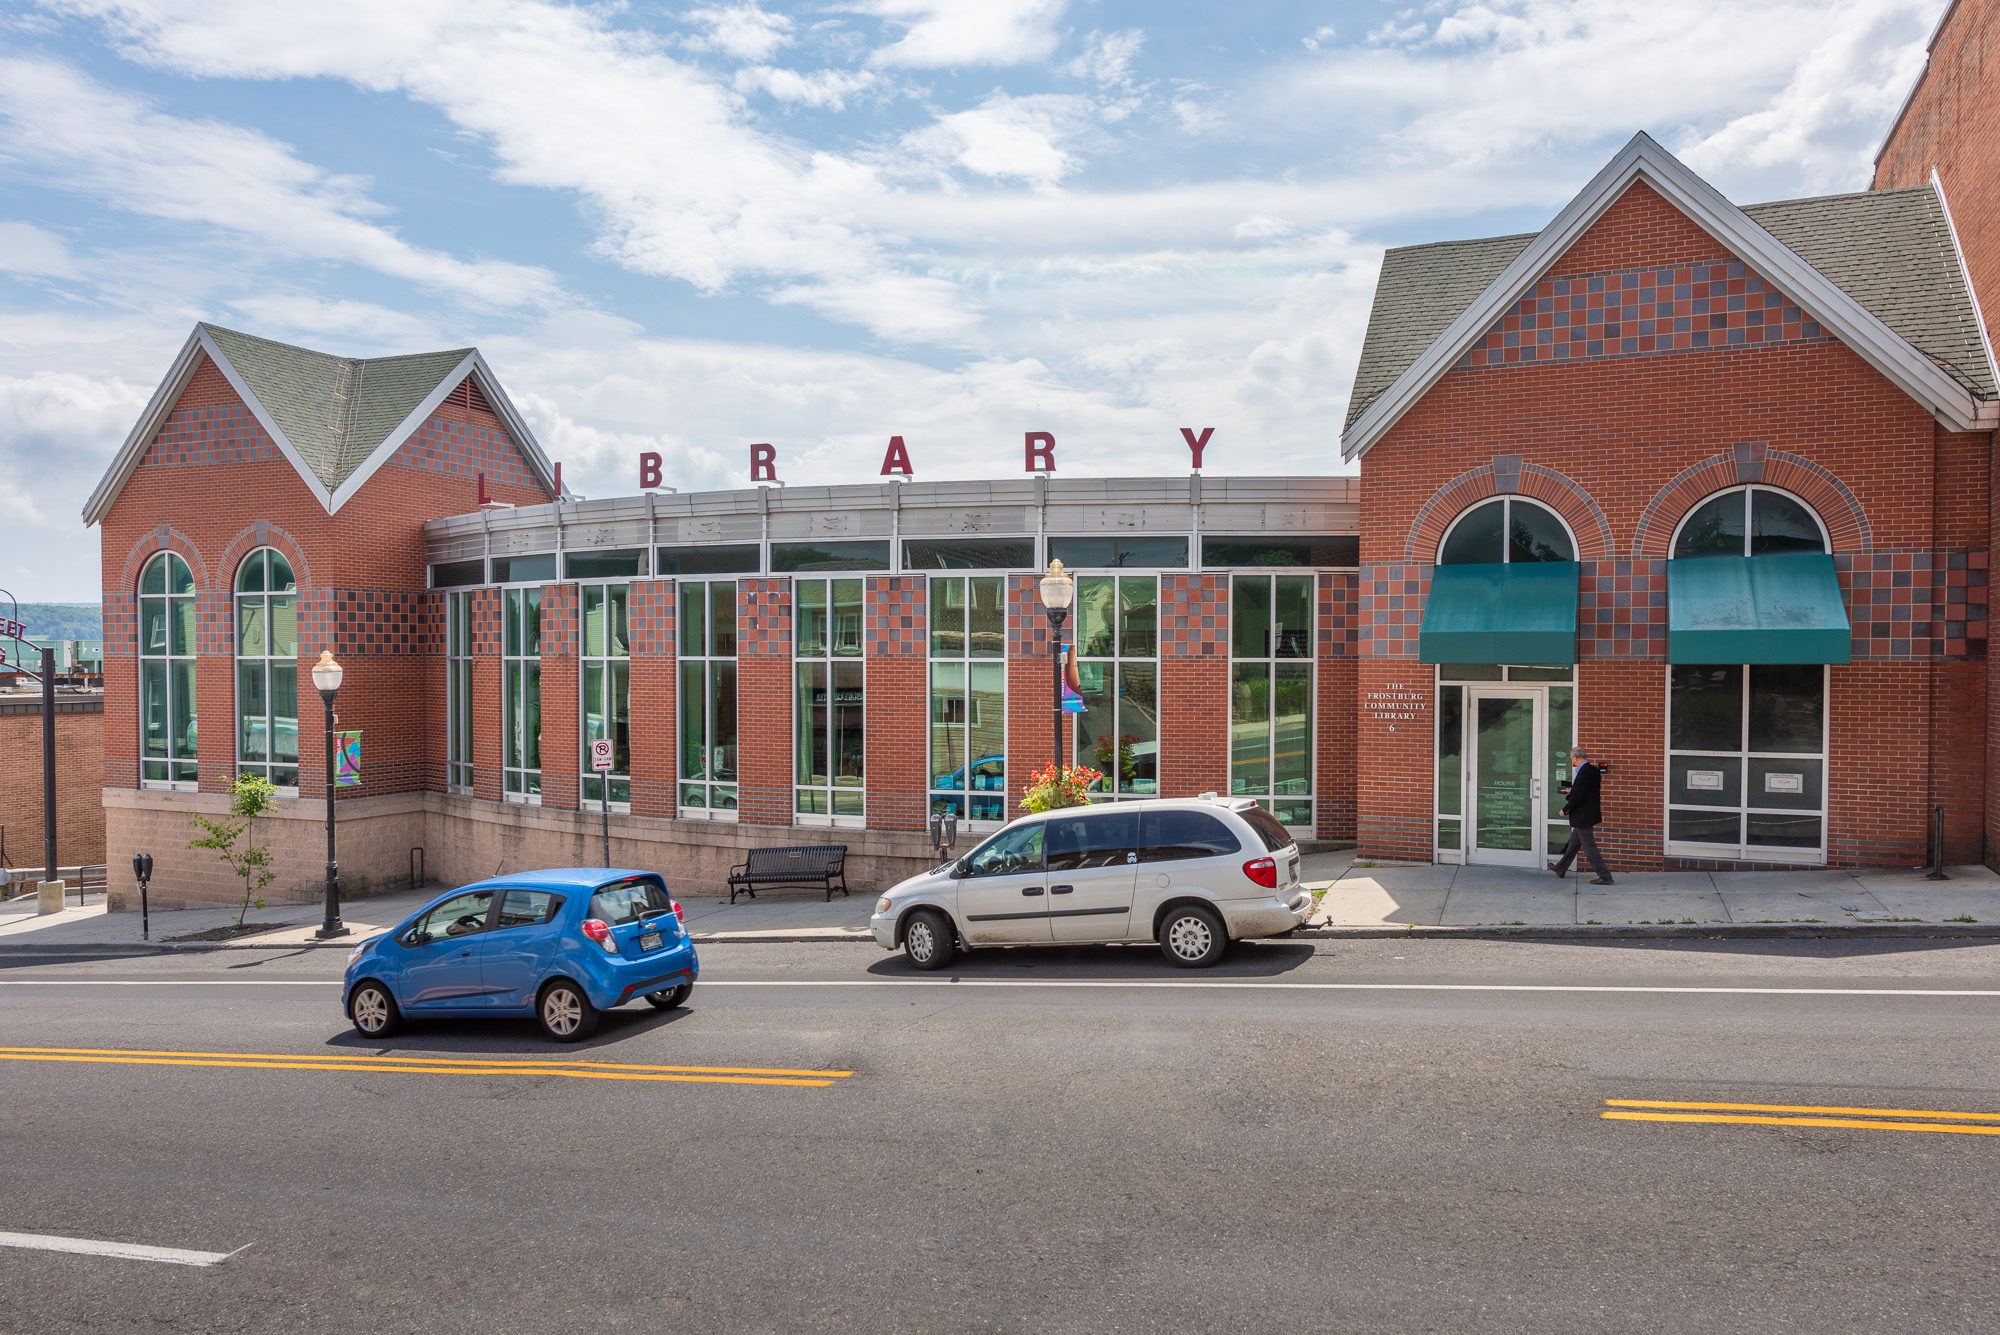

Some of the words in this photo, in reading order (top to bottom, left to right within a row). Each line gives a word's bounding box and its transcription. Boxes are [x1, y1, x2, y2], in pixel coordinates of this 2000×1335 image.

[478, 427, 1215, 505] LIBRARY
[1367, 692, 1423, 700] FROSTBURG
[1364, 702, 1426, 710] COMMUNITY
[1374, 712, 1416, 720] LIBRARY
